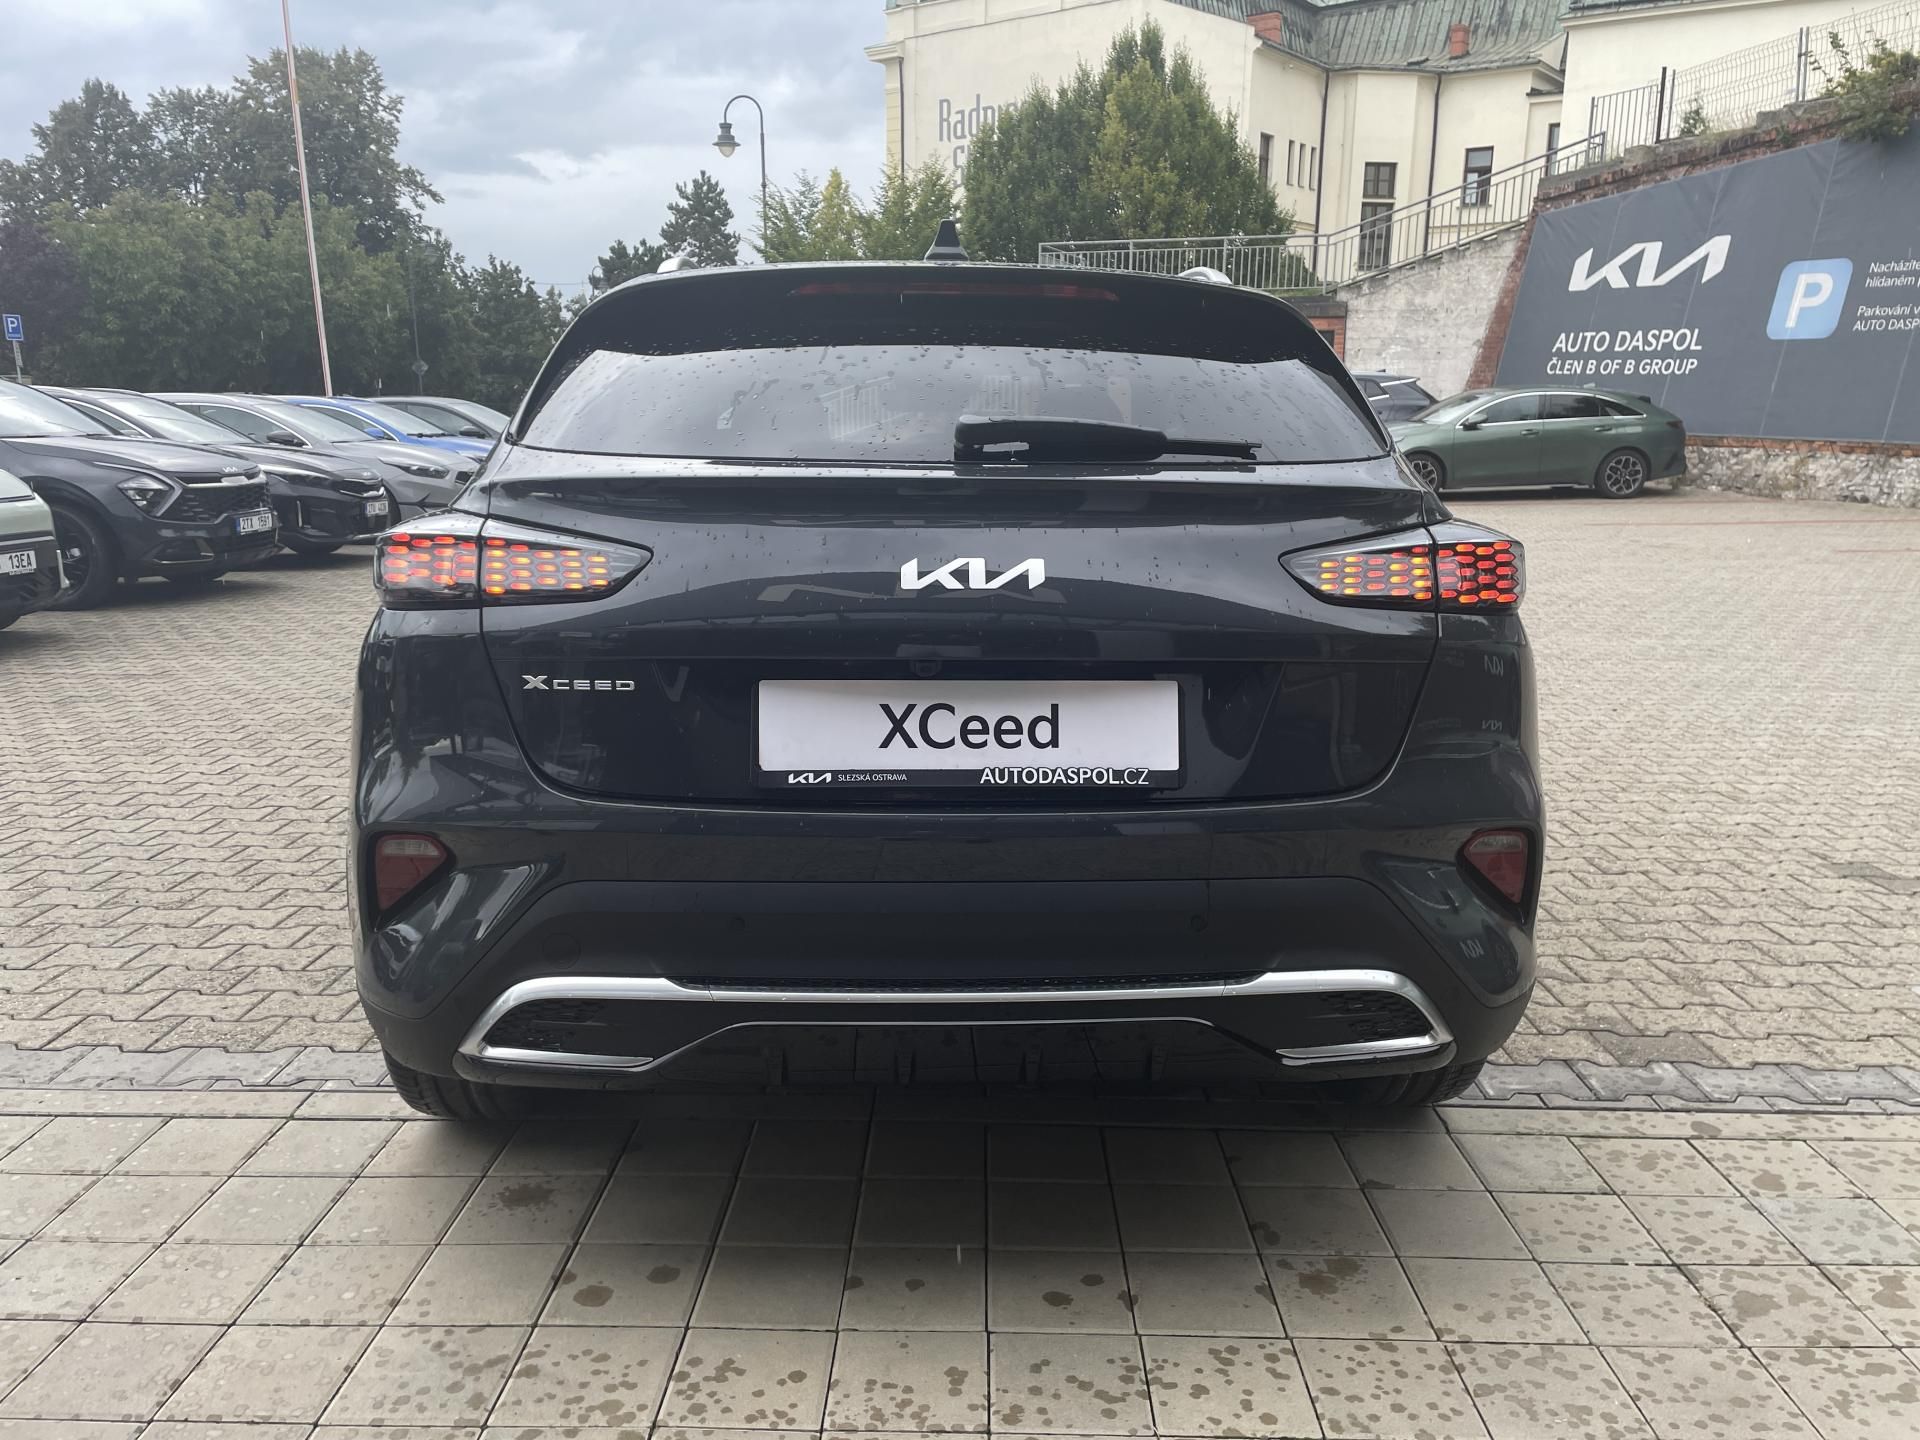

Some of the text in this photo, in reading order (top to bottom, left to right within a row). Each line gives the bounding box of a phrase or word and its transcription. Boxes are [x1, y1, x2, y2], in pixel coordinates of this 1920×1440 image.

[939, 93, 1019, 142] Radn
[1568, 234, 1732, 292] KIA
[1865, 274, 1915, 288] hlídaném
[1784, 272, 1834, 329] P
[1857, 304, 1912, 317] Parkování
[7, 317, 18, 333] P
[1852, 318, 1920, 331] AUTO DASP
[1552, 328, 1702, 353] AUTO DASPOL
[1547, 357, 1698, 375] ČLEN B OF B GROUP
[9, 552, 33, 569] 13EA
[900, 557, 1046, 590] KIA
[878, 702, 1060, 750] XCeed
[788, 767, 1149, 785] KIA SLEZSKÁ OSTRAVA AUTODASPOL.CZ
